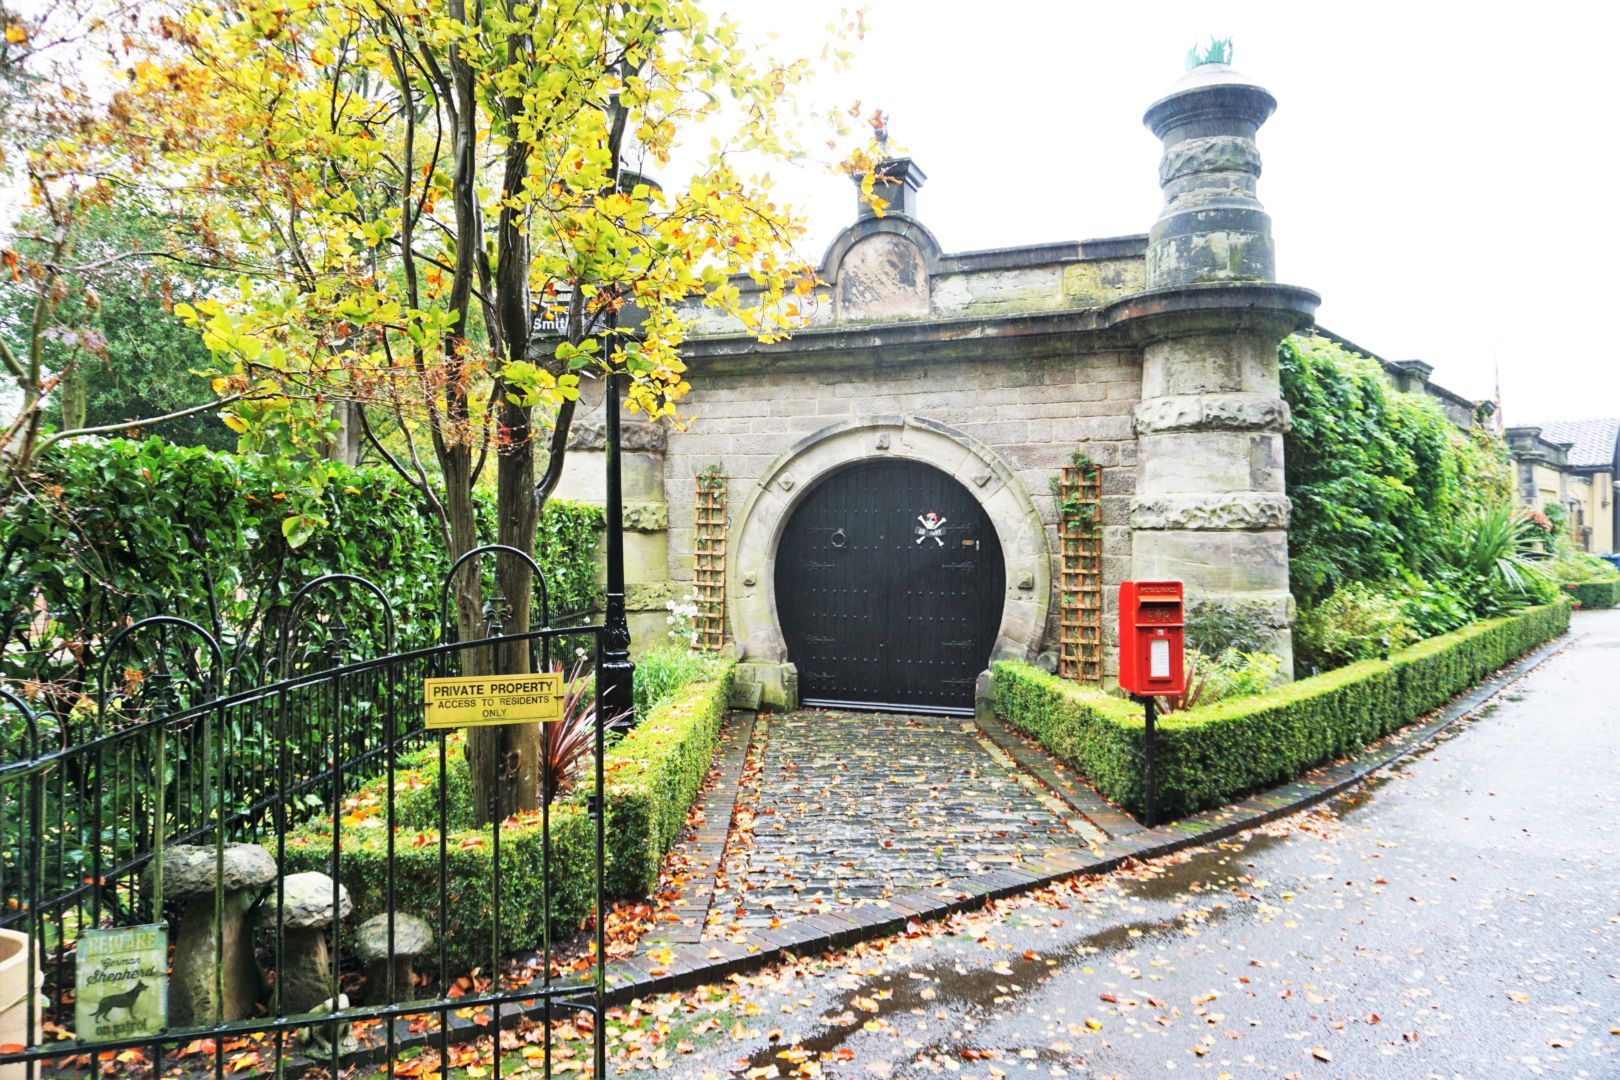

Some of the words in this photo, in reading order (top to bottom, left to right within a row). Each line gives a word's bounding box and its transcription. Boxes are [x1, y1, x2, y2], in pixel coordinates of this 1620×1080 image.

[433, 684, 484, 697] PRIVATE
[490, 681, 553, 694] PROPERTY
[438, 699, 476, 709] ACCESS
[482, 698, 494, 707] TO
[500, 695, 550, 706] RESIDENTS
[482, 708, 507, 718] ONLY
[88, 932, 157, 953] BEWARE
[101, 957, 141, 970] German
[86, 965, 157, 987] Shepherd
[96, 1025, 111, 1036] on
[112, 1018, 147, 1035] patrol
